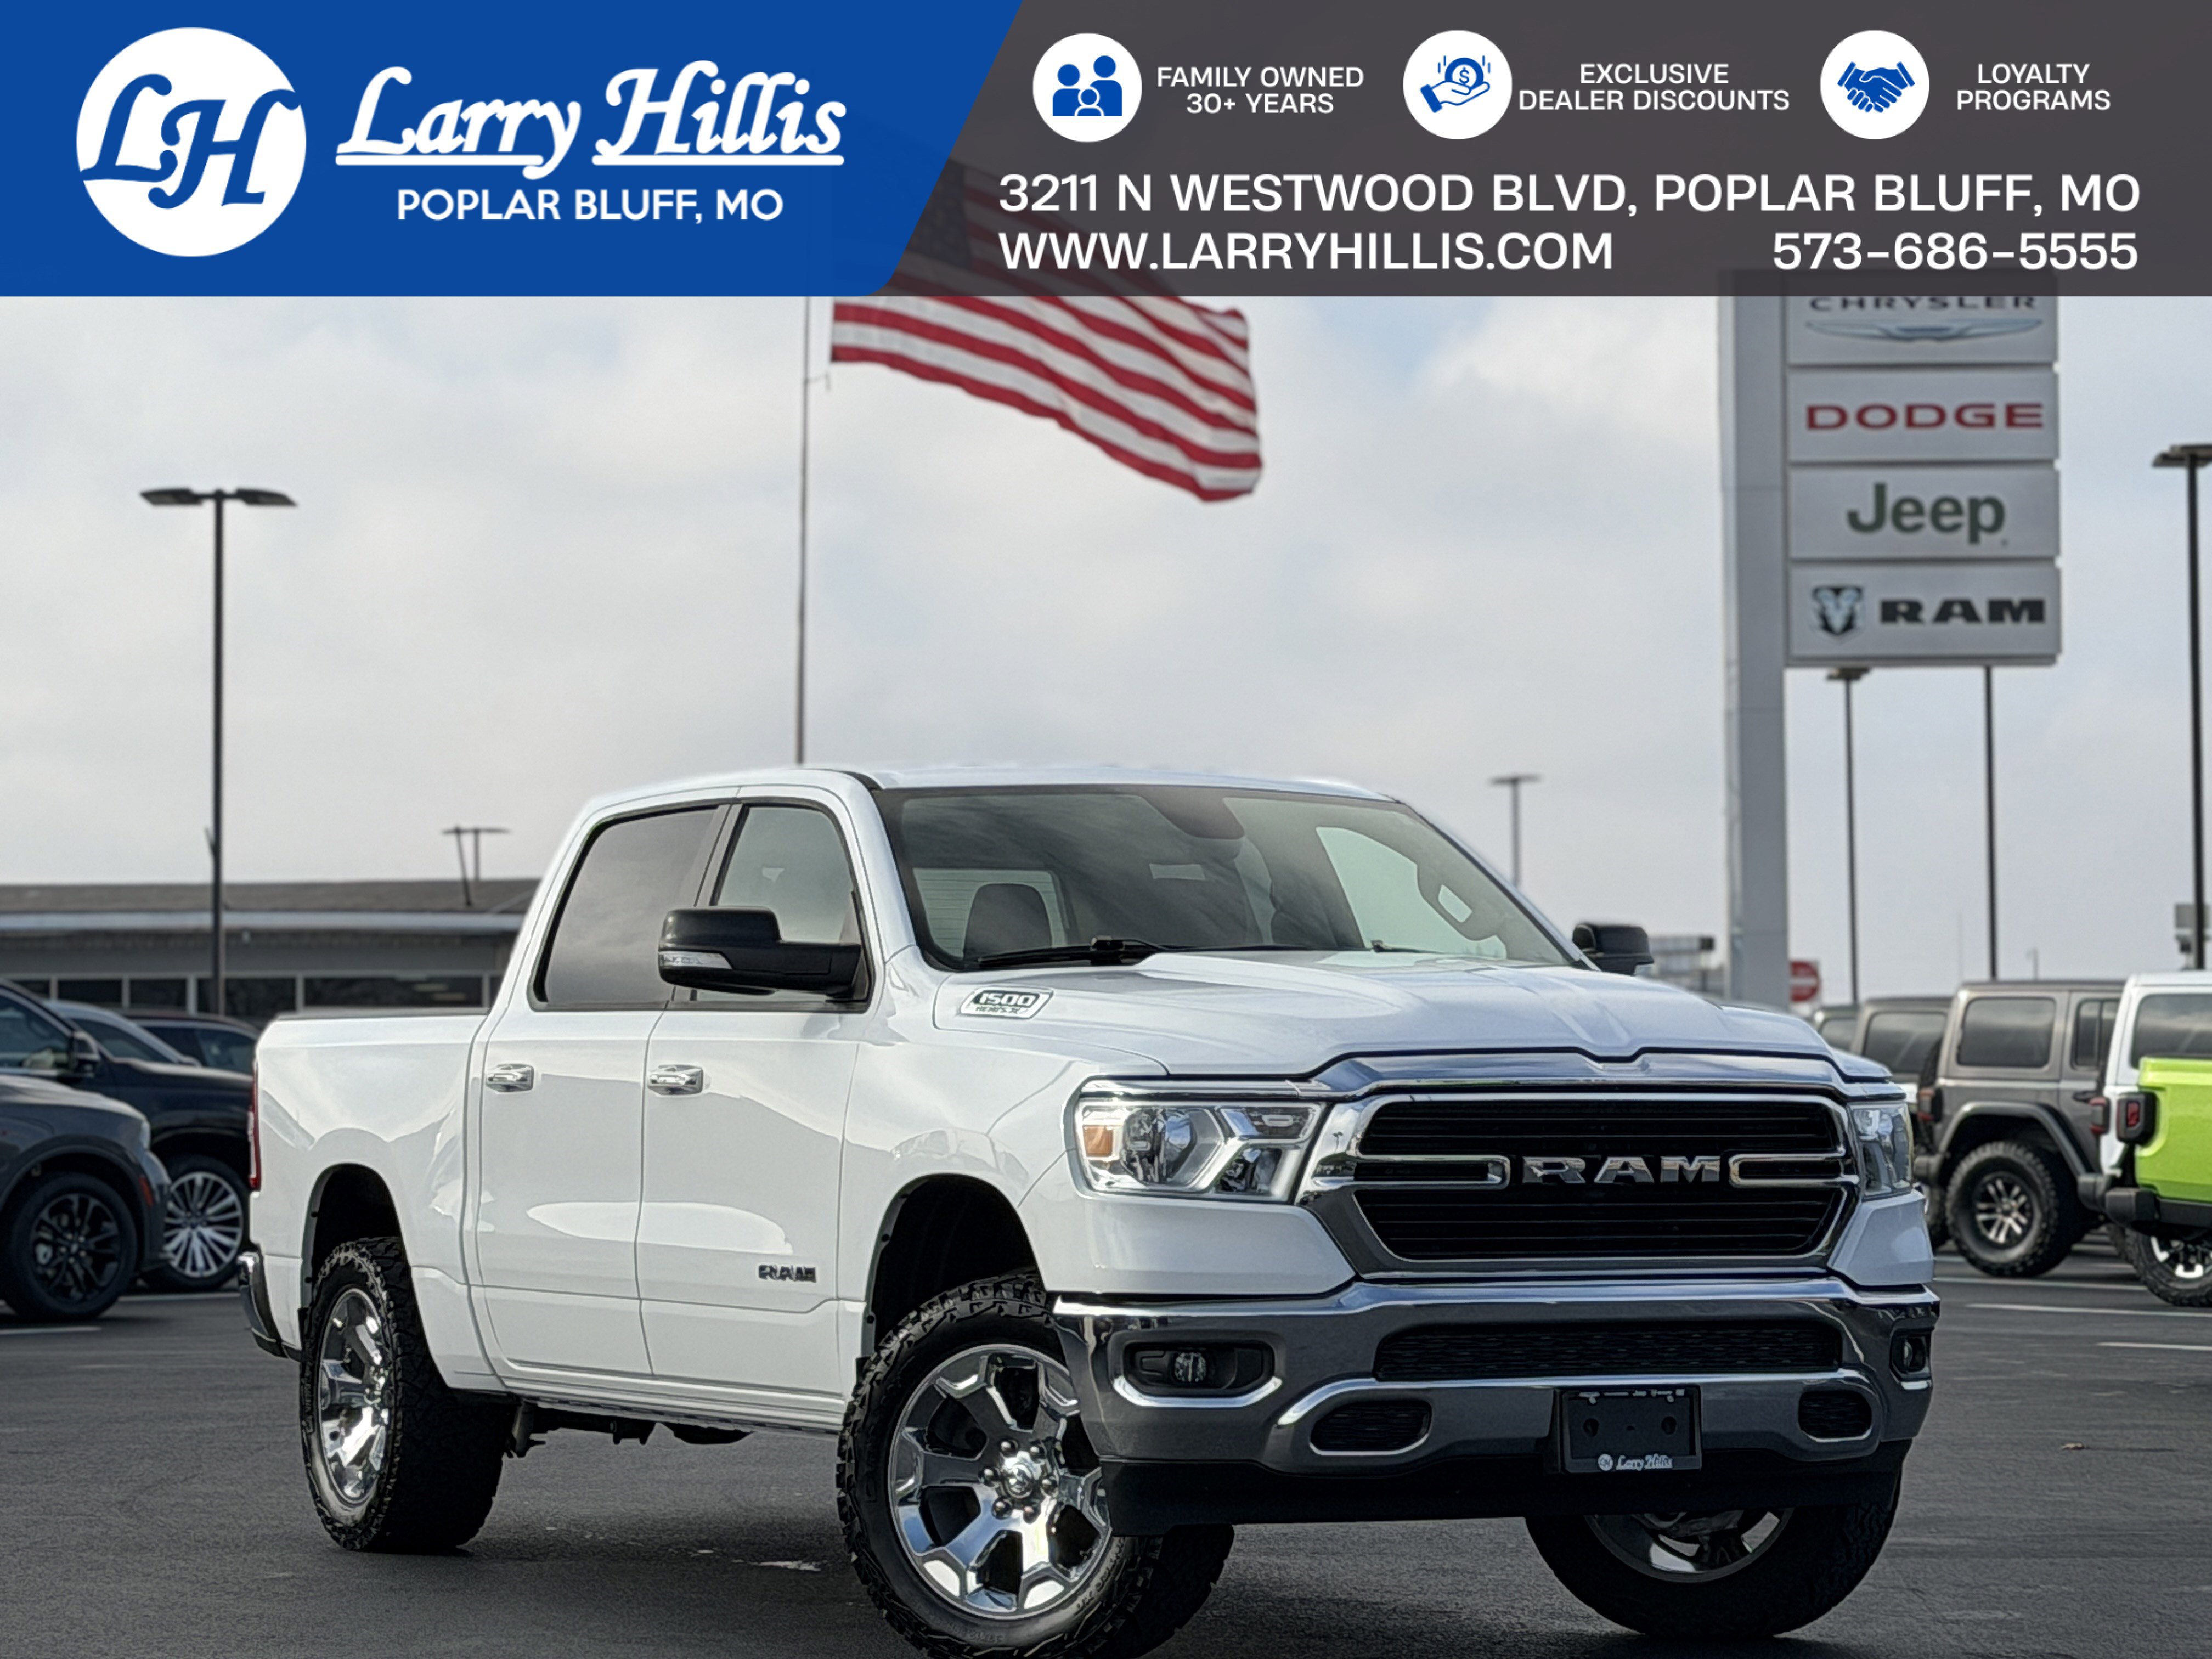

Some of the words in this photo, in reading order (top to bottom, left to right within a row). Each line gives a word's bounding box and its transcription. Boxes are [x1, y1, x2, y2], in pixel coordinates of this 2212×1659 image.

[1809, 296, 2036, 311] CHRYSLER
[1806, 403, 2044, 430] DODGE
[1847, 483, 2006, 544] Jeep
[1880, 599, 2045, 624] RAM
[979, 992, 1035, 1006] 1500
[1522, 1156, 1720, 1184] RAM
[758, 1265, 816, 1283] RAM
